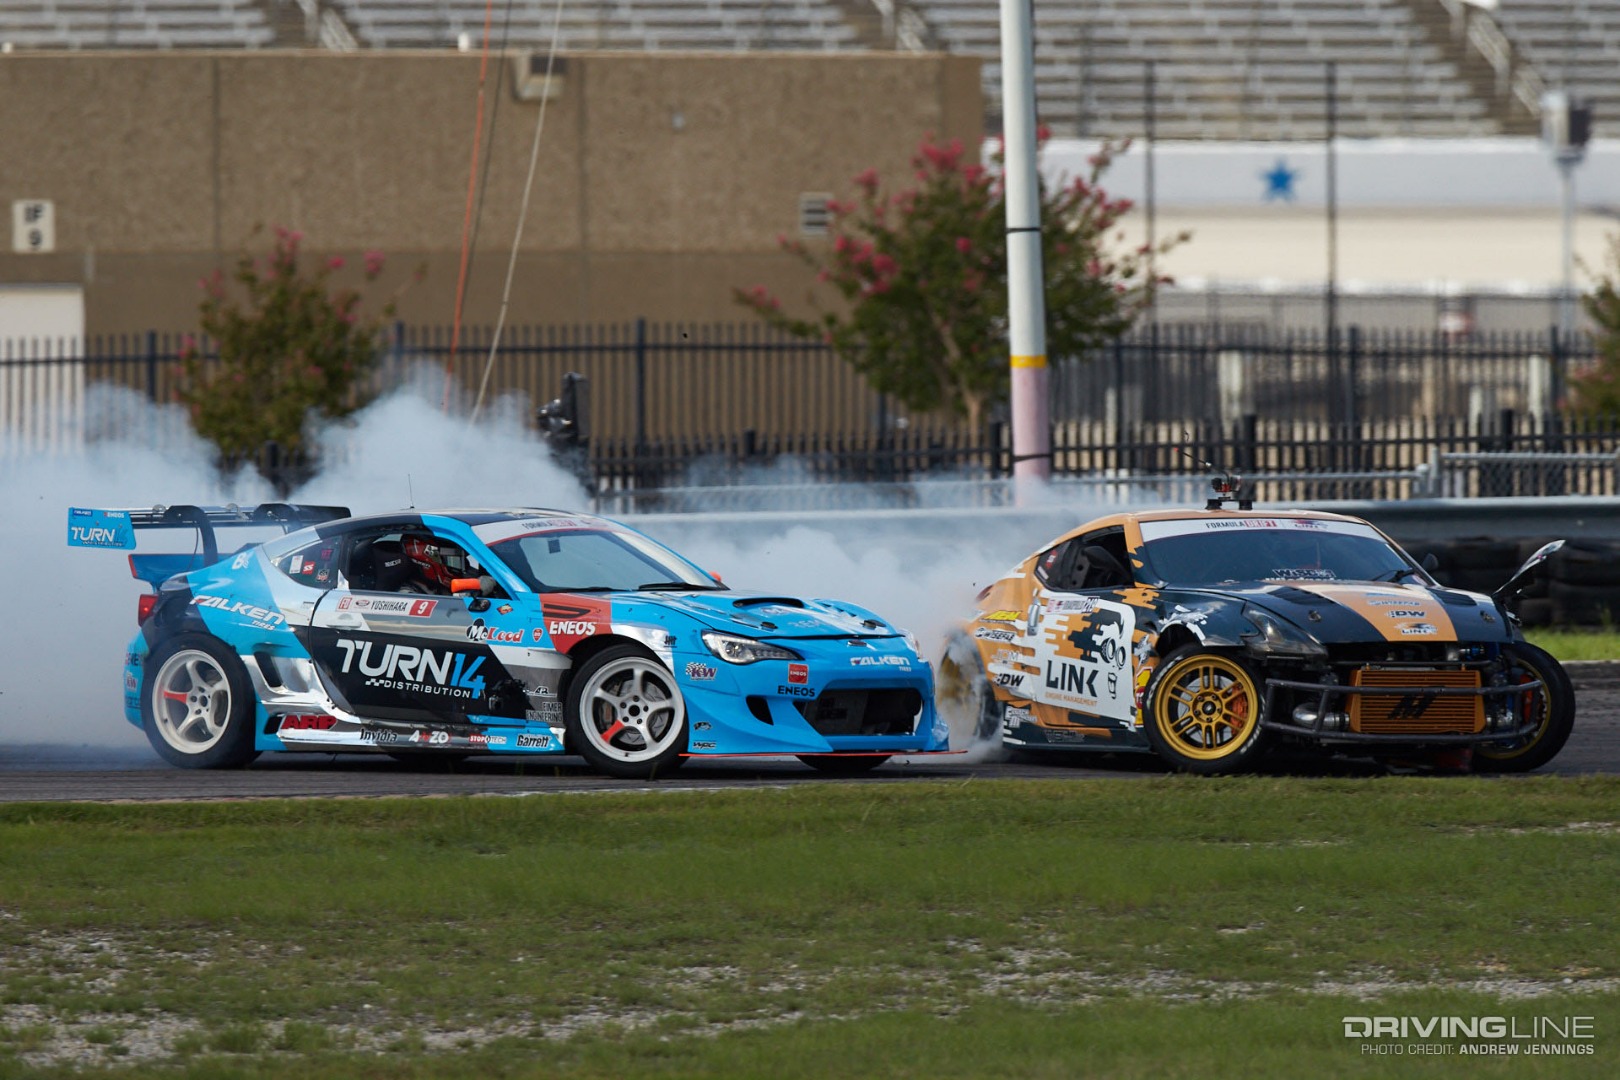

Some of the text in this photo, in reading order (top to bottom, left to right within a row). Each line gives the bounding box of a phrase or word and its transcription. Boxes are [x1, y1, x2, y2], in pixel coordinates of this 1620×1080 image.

[1205, 521, 1244, 529] FORMULA
[189, 595, 286, 625] FALKEN
[370, 600, 408, 612] YOSHIHARA
[417, 601, 429, 615] 9
[466, 624, 524, 642] McLeod
[549, 621, 598, 636] ENEOS
[850, 656, 911, 666] FALKEN
[1046, 660, 1099, 698] LINK
[383, 679, 471, 699] DISTRIBUTION
[777, 685, 816, 697] ENEOS
[281, 715, 337, 730] ARP
[360, 728, 398, 743] Invidia
[516, 734, 550, 748] Garrett
